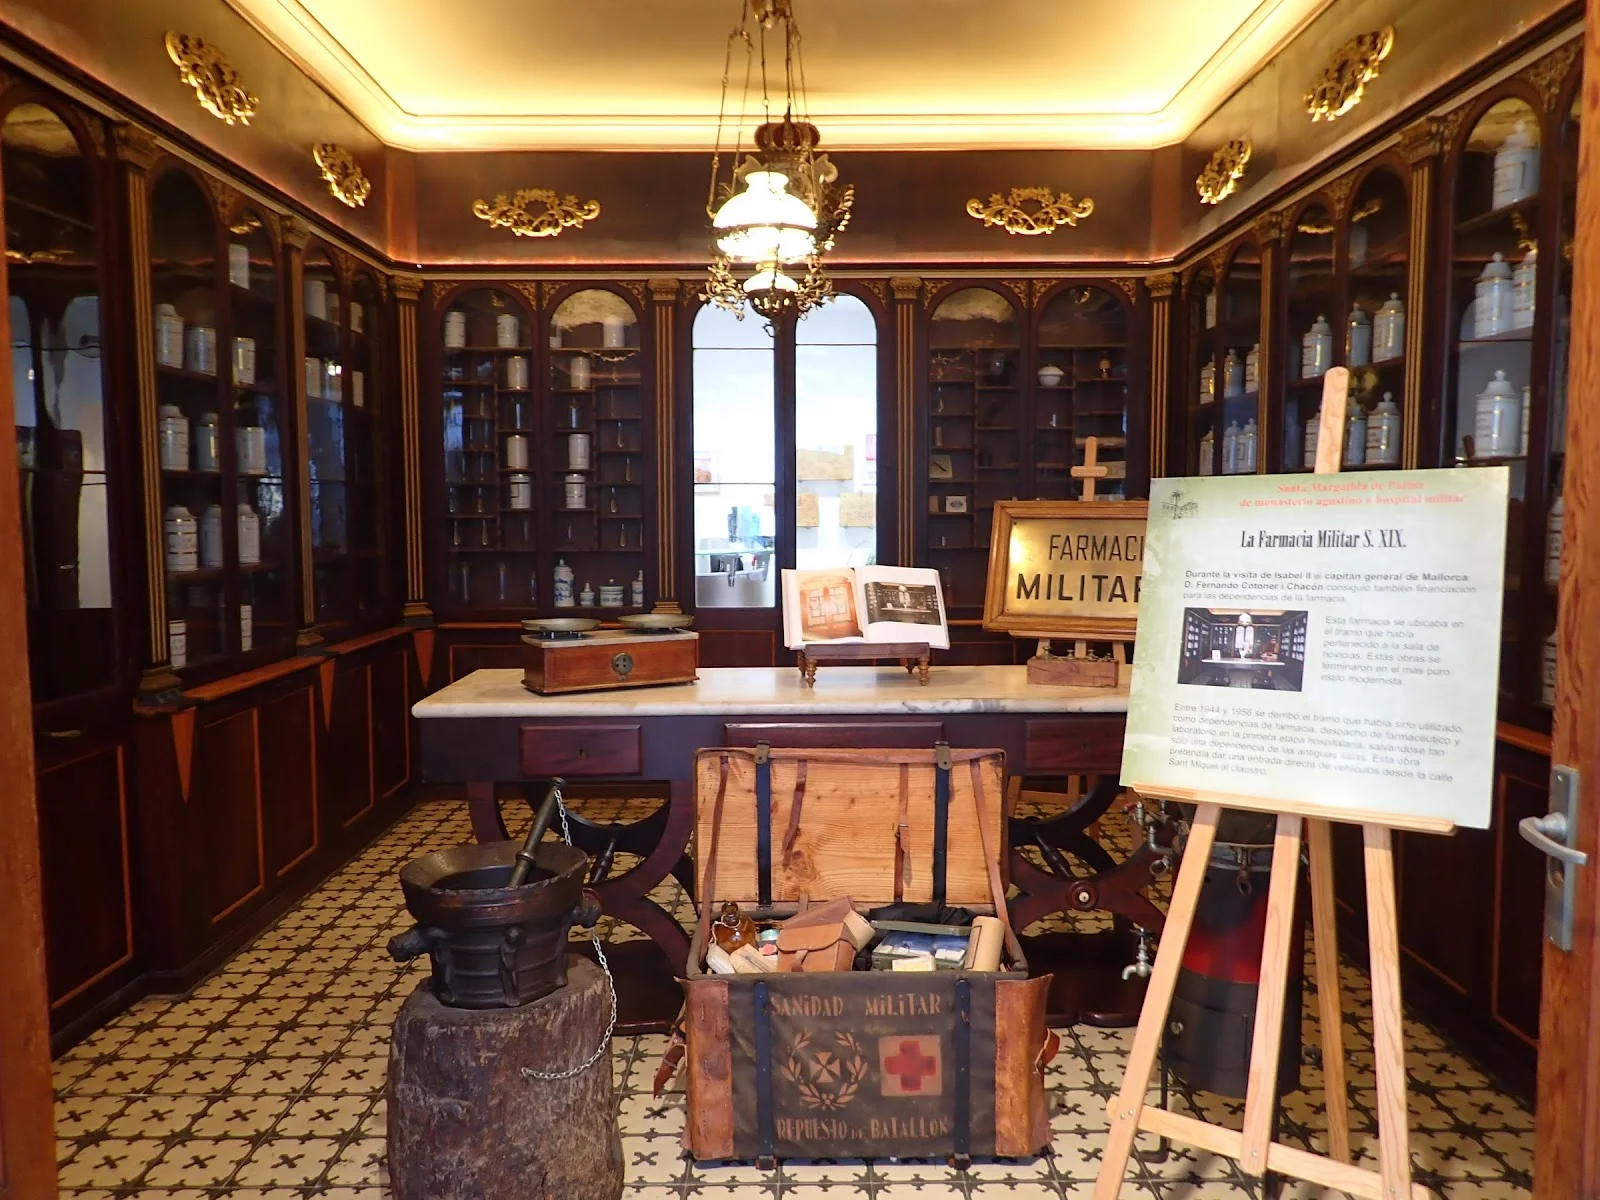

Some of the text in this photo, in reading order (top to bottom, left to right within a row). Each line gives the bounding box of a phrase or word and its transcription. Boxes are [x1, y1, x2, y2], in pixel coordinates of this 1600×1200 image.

[1277, 484, 1306, 493] Santa
[1371, 482, 1384, 490] de
[1388, 480, 1424, 490] Palma
[1240, 498, 1251, 507] de
[1254, 497, 1312, 506] monasterio
[1316, 496, 1362, 508] agustino
[1376, 494, 1422, 506] hospital
[1425, 493, 1465, 504] militar
[1240, 529, 1406, 548] La Farmacia Militar S. XIX.
[1185, 570, 1220, 578] Durante
[1223, 570, 1230, 578] la
[1233, 570, 1258, 579] visita
[1260, 571, 1272, 579] de
[1274, 571, 1302, 580] Isabel
[1364, 572, 1402, 582] general
[1406, 572, 1418, 581] de
[1422, 572, 1469, 582] Mallorca
[1196, 581, 1238, 590] Fernando
[1242, 582, 1278, 590] Cotoner
[1183, 592, 1202, 600] para
[1219, 592, 1278, 602] dependencias
[1325, 616, 1346, 624] Esta
[1349, 616, 1390, 626] farmacia
[1394, 618, 1404, 626] se
[1408, 619, 1448, 628] ubicaba
[1336, 628, 1362, 636] tramo
[1366, 630, 1383, 638] que
[1324, 640, 1380, 650] pertenecido
[1392, 642, 1400, 650] la
[1404, 642, 1424, 651] sala
[1427, 643, 1440, 652] de
[1366, 652, 1394, 662] Estas
[1397, 654, 1426, 663] obras
[1428, 656, 1440, 664] se
[1322, 662, 1372, 672] terminaron
[1426, 668, 1451, 676] puro
[1320, 674, 1346, 682] estilo
[1174, 702, 1197, 712] Entre
[1221, 706, 1228, 716] y
[1254, 709, 1265, 718] se
[1302, 712, 1310, 721] el
[1314, 714, 1340, 724] tramo
[1344, 716, 1361, 726] que
[1394, 720, 1416, 730] sido
[1173, 714, 1196, 724] como
[1198, 716, 1258, 728] dependencias
[1261, 720, 1272, 730] de
[1320, 726, 1367, 738] despacho
[1370, 730, 1382, 739] de
[1454, 738, 1461, 747] y
[1172, 724, 1216, 737] laboratorio
[1232, 730, 1240, 738] la
[1242, 731, 1276, 742] primera
[1280, 734, 1306, 744] etapa
[1428, 747, 1446, 756] tan
[1190, 738, 1206, 746] una
[1209, 739, 1264, 752] dependencia
[1268, 744, 1278, 753] de
[1282, 746, 1294, 754] las
[1298, 748, 1338, 759] antiguas
[1372, 754, 1394, 764] Esta
[1397, 756, 1420, 767] obra
[1168, 757, 1188, 767] Sant
[1221, 764, 1229, 772] al
[1212, 750, 1226, 760] dar
[1228, 753, 1244, 762] una
[1248, 755, 1282, 766] entrada
[1284, 758, 1316, 768] directa
[1318, 761, 1330, 770] de
[1382, 768, 1414, 778] desde
[1416, 770, 1426, 780] la
[1428, 772, 1453, 782] calle
